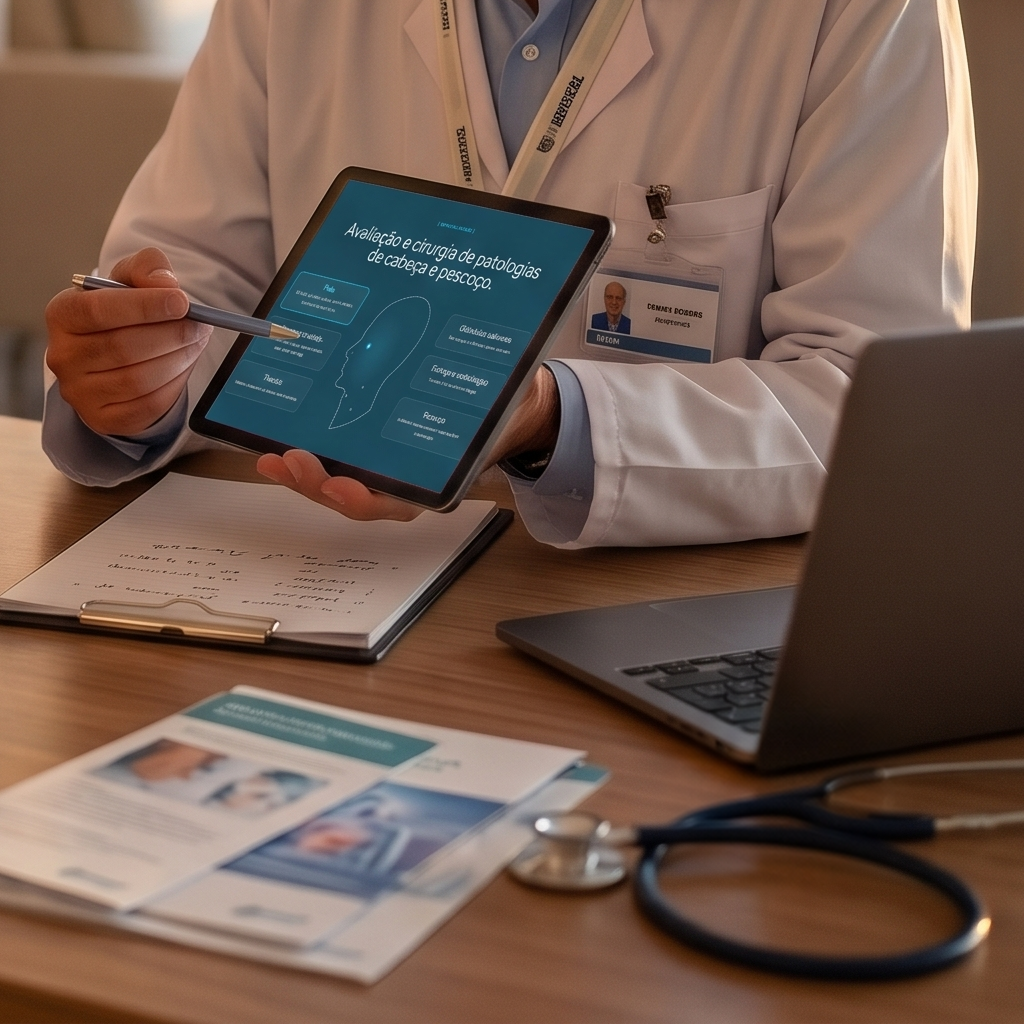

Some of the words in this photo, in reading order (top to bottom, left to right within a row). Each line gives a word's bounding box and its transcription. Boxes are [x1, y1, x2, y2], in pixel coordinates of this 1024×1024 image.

[367, 248, 385, 264] de
[384, 254, 428, 277] cabeça
[428, 265, 439, 277] e
[435, 267, 492, 292] pescoço.
[402, 238, 412, 250] e
[411, 238, 458, 262] cirurgia
[458, 248, 476, 264] de
[473, 255, 542, 280] patologias
